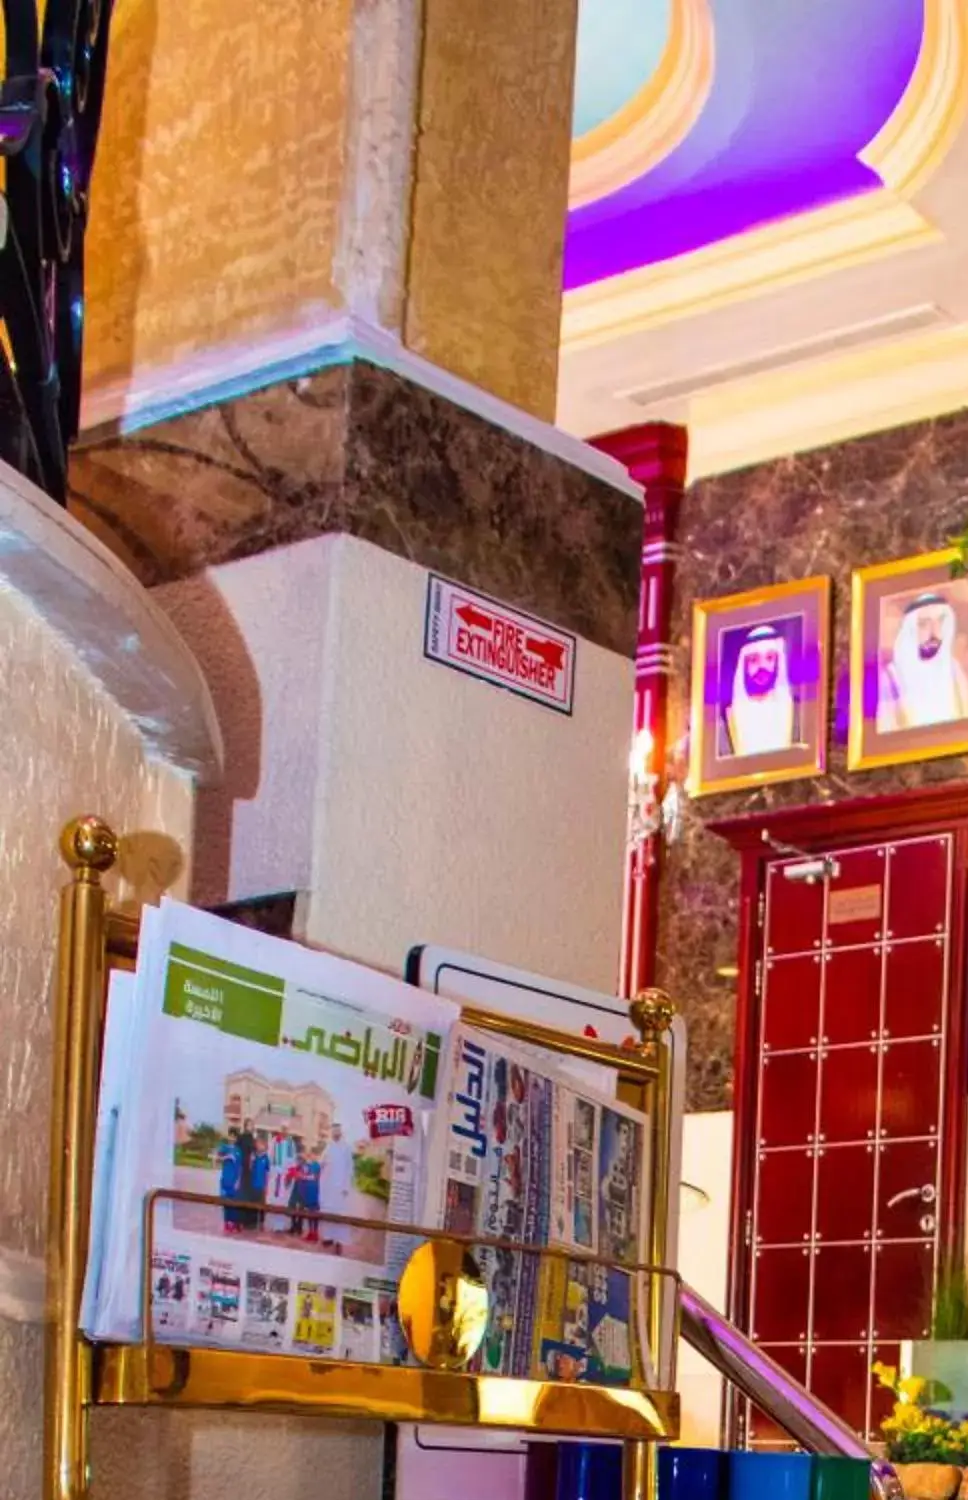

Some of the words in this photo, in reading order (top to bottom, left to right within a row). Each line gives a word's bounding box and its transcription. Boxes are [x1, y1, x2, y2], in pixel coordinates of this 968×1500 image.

[456, 626, 556, 691] EXTINGUISHER
[493, 618, 525, 648] FIRE
[282, 1025, 408, 1083] الرياضي
[451, 1039, 488, 1158] الدليل
